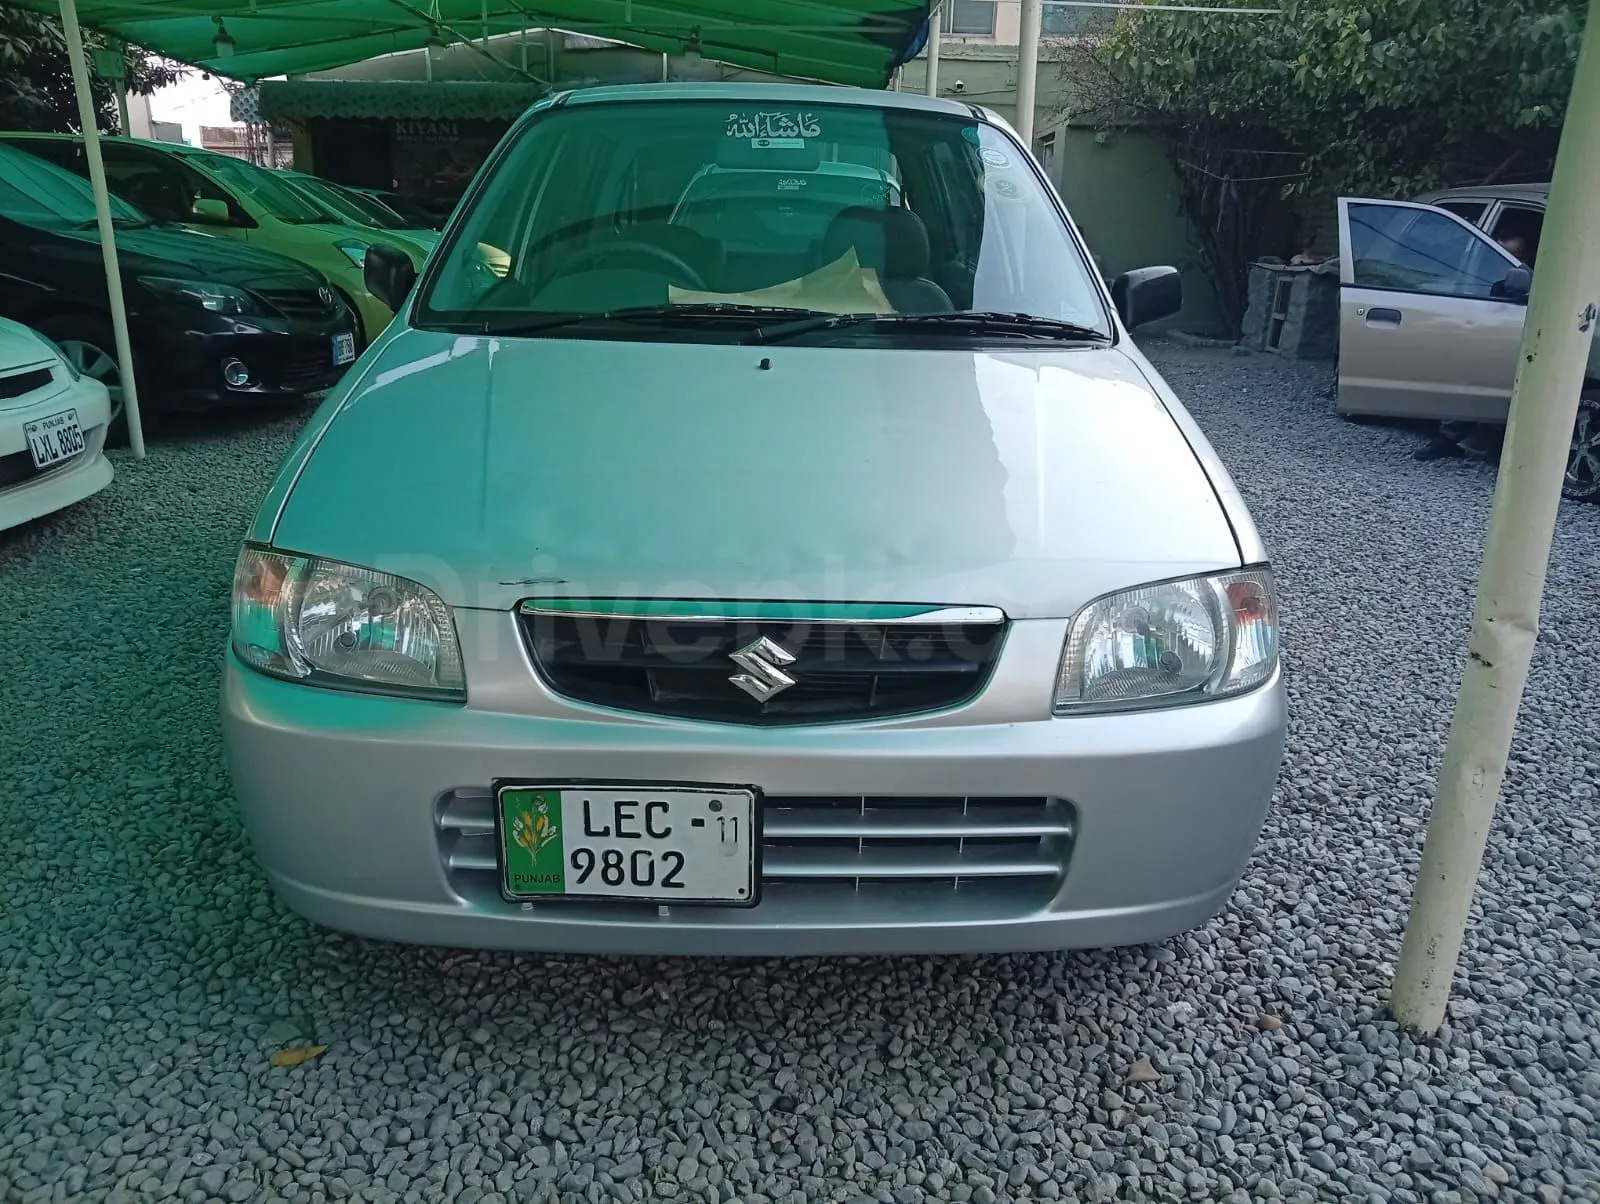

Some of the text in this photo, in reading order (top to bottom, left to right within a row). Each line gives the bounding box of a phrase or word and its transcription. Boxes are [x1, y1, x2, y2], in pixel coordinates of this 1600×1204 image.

[32, 424, 83, 464] LXL 8805
[583, 800, 672, 838] LEC
[514, 874, 561, 885] PUNJAB
[571, 848, 685, 888] 9802
